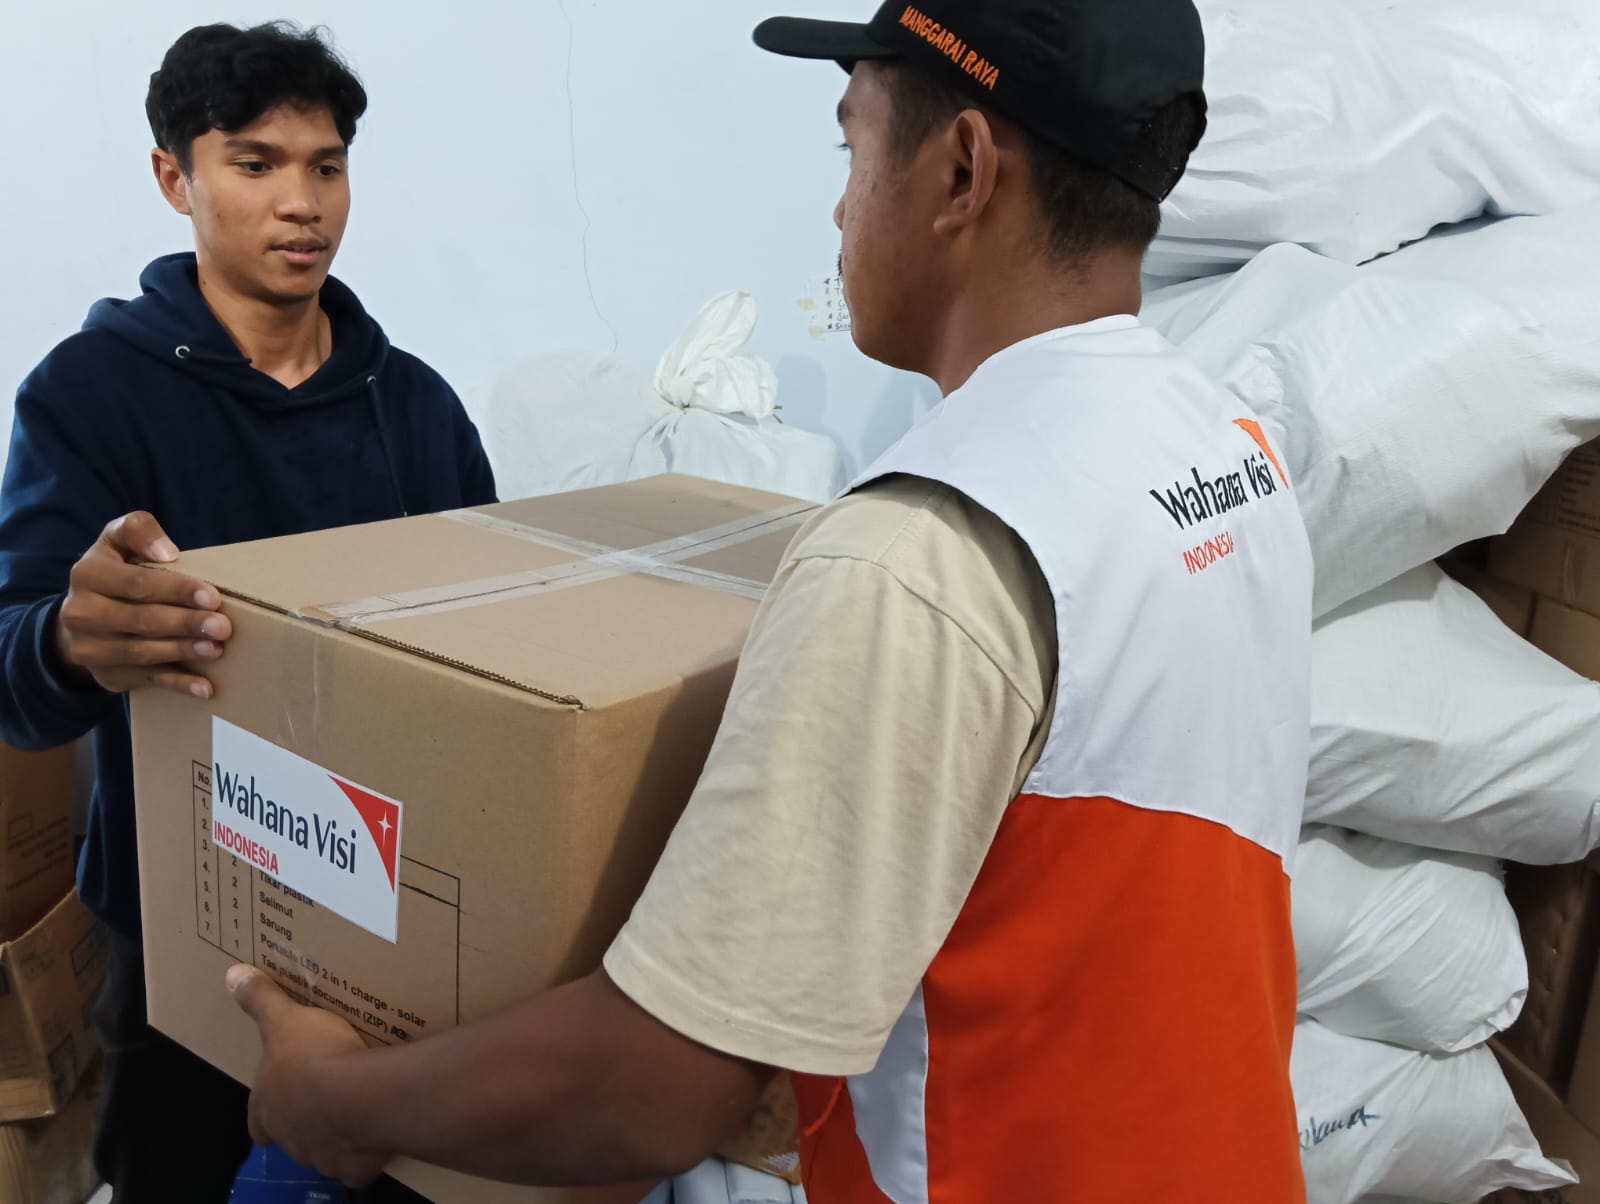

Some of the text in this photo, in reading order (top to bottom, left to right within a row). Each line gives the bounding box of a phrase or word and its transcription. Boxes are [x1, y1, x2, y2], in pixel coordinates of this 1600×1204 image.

[898, 4, 1000, 91] MANGGARAI RAYA
[1149, 452, 1277, 530] Wahana Visi
[214, 762, 357, 874] Wahana Visi
[214, 820, 279, 875] INDONESIA
[231, 876, 238, 889] 2
[232, 897, 239, 910] 2
[259, 890, 294, 919] Selimut
[259, 911, 292, 942] Sarung
[300, 955, 320, 975] LED
[321, 967, 328, 980] 2
[330, 971, 339, 987] in
[342, 978, 348, 991] 1
[350, 984, 387, 1010] charge
[397, 1008, 426, 1028] solar
[311, 984, 361, 1019] document
[362, 1010, 388, 1034] (ZIP)
